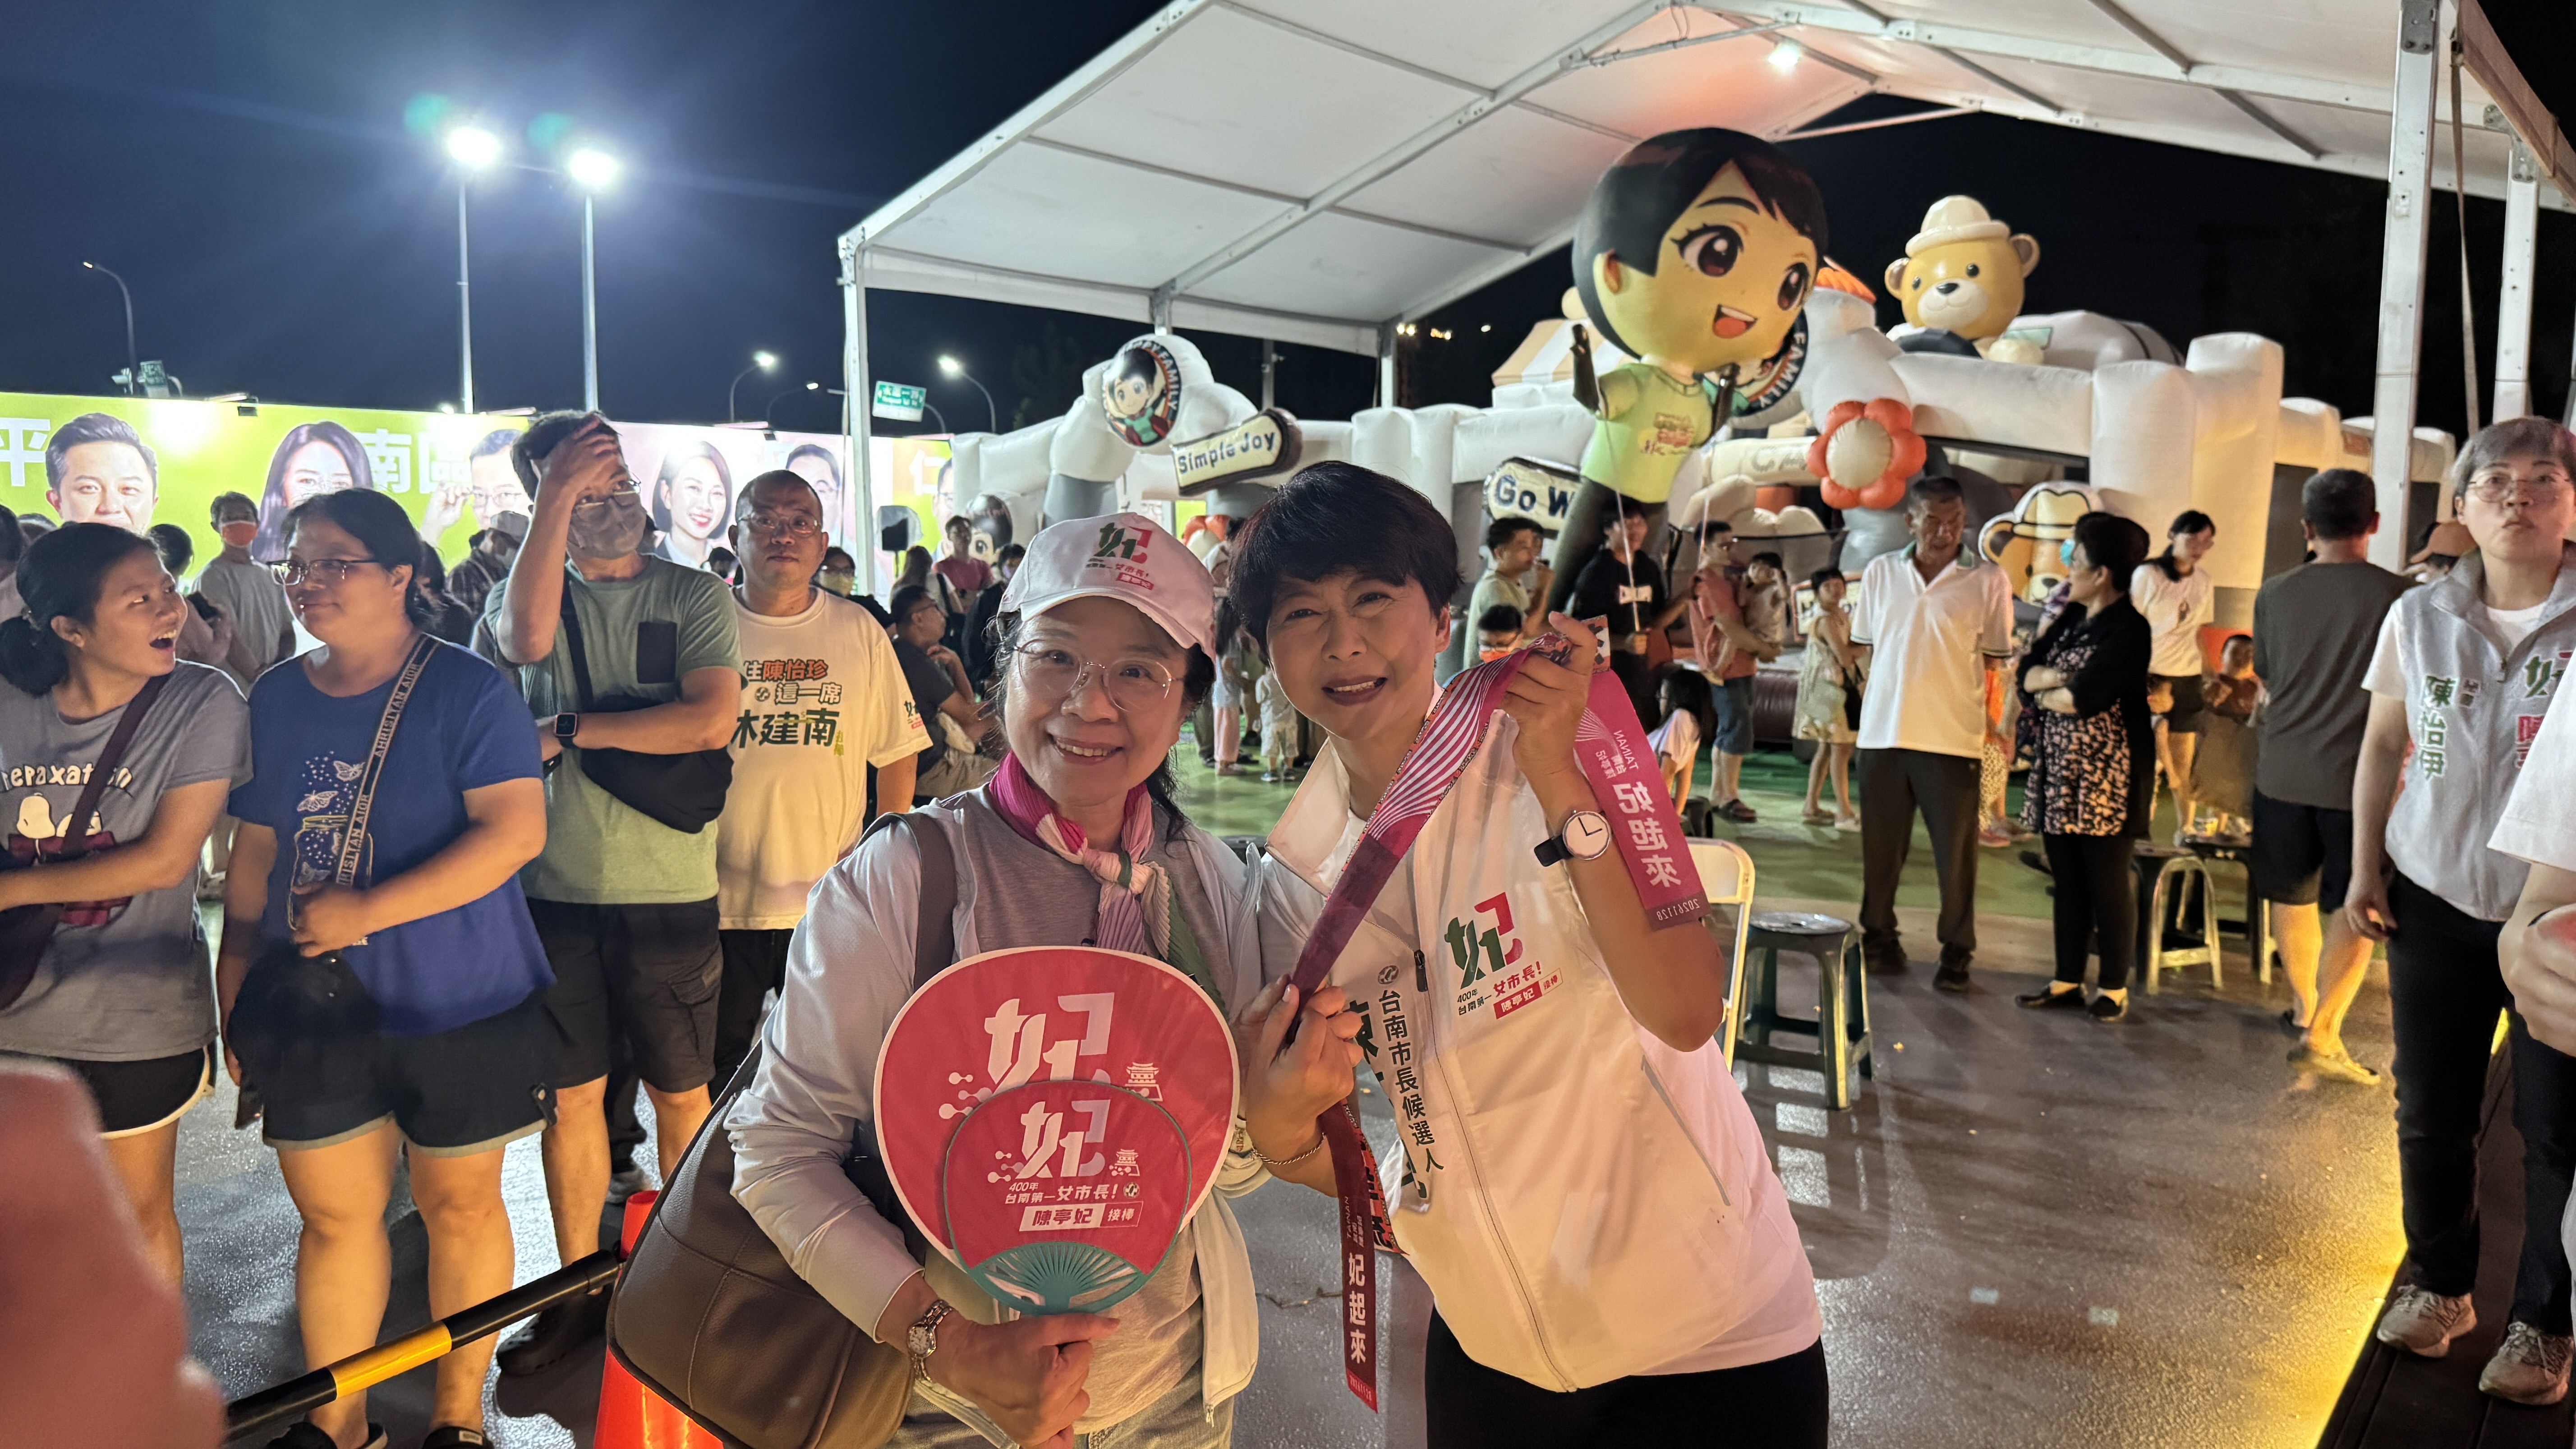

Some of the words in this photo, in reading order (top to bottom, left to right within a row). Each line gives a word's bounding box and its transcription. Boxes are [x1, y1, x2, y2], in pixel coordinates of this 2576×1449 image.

[1758, 332, 1806, 409] FAMILY
[0, 417, 51, 487] 平
[1178, 442, 1236, 474] Simple
[1241, 432, 1275, 453] Joy
[1494, 474, 1536, 512] Go
[774, 682, 842, 705] 這一席
[1444, 891, 1523, 990] 妃
[1379, 989, 1444, 1173] 台南市長候選人
[1015, 1099, 1111, 1179] 妃
[1009, 1182, 1039, 1191] 400年
[1032, 1208, 1094, 1226] 陳亭妃
[1107, 1208, 1135, 1222] 接棒
[1348, 1252, 1366, 1364] 妃起來
